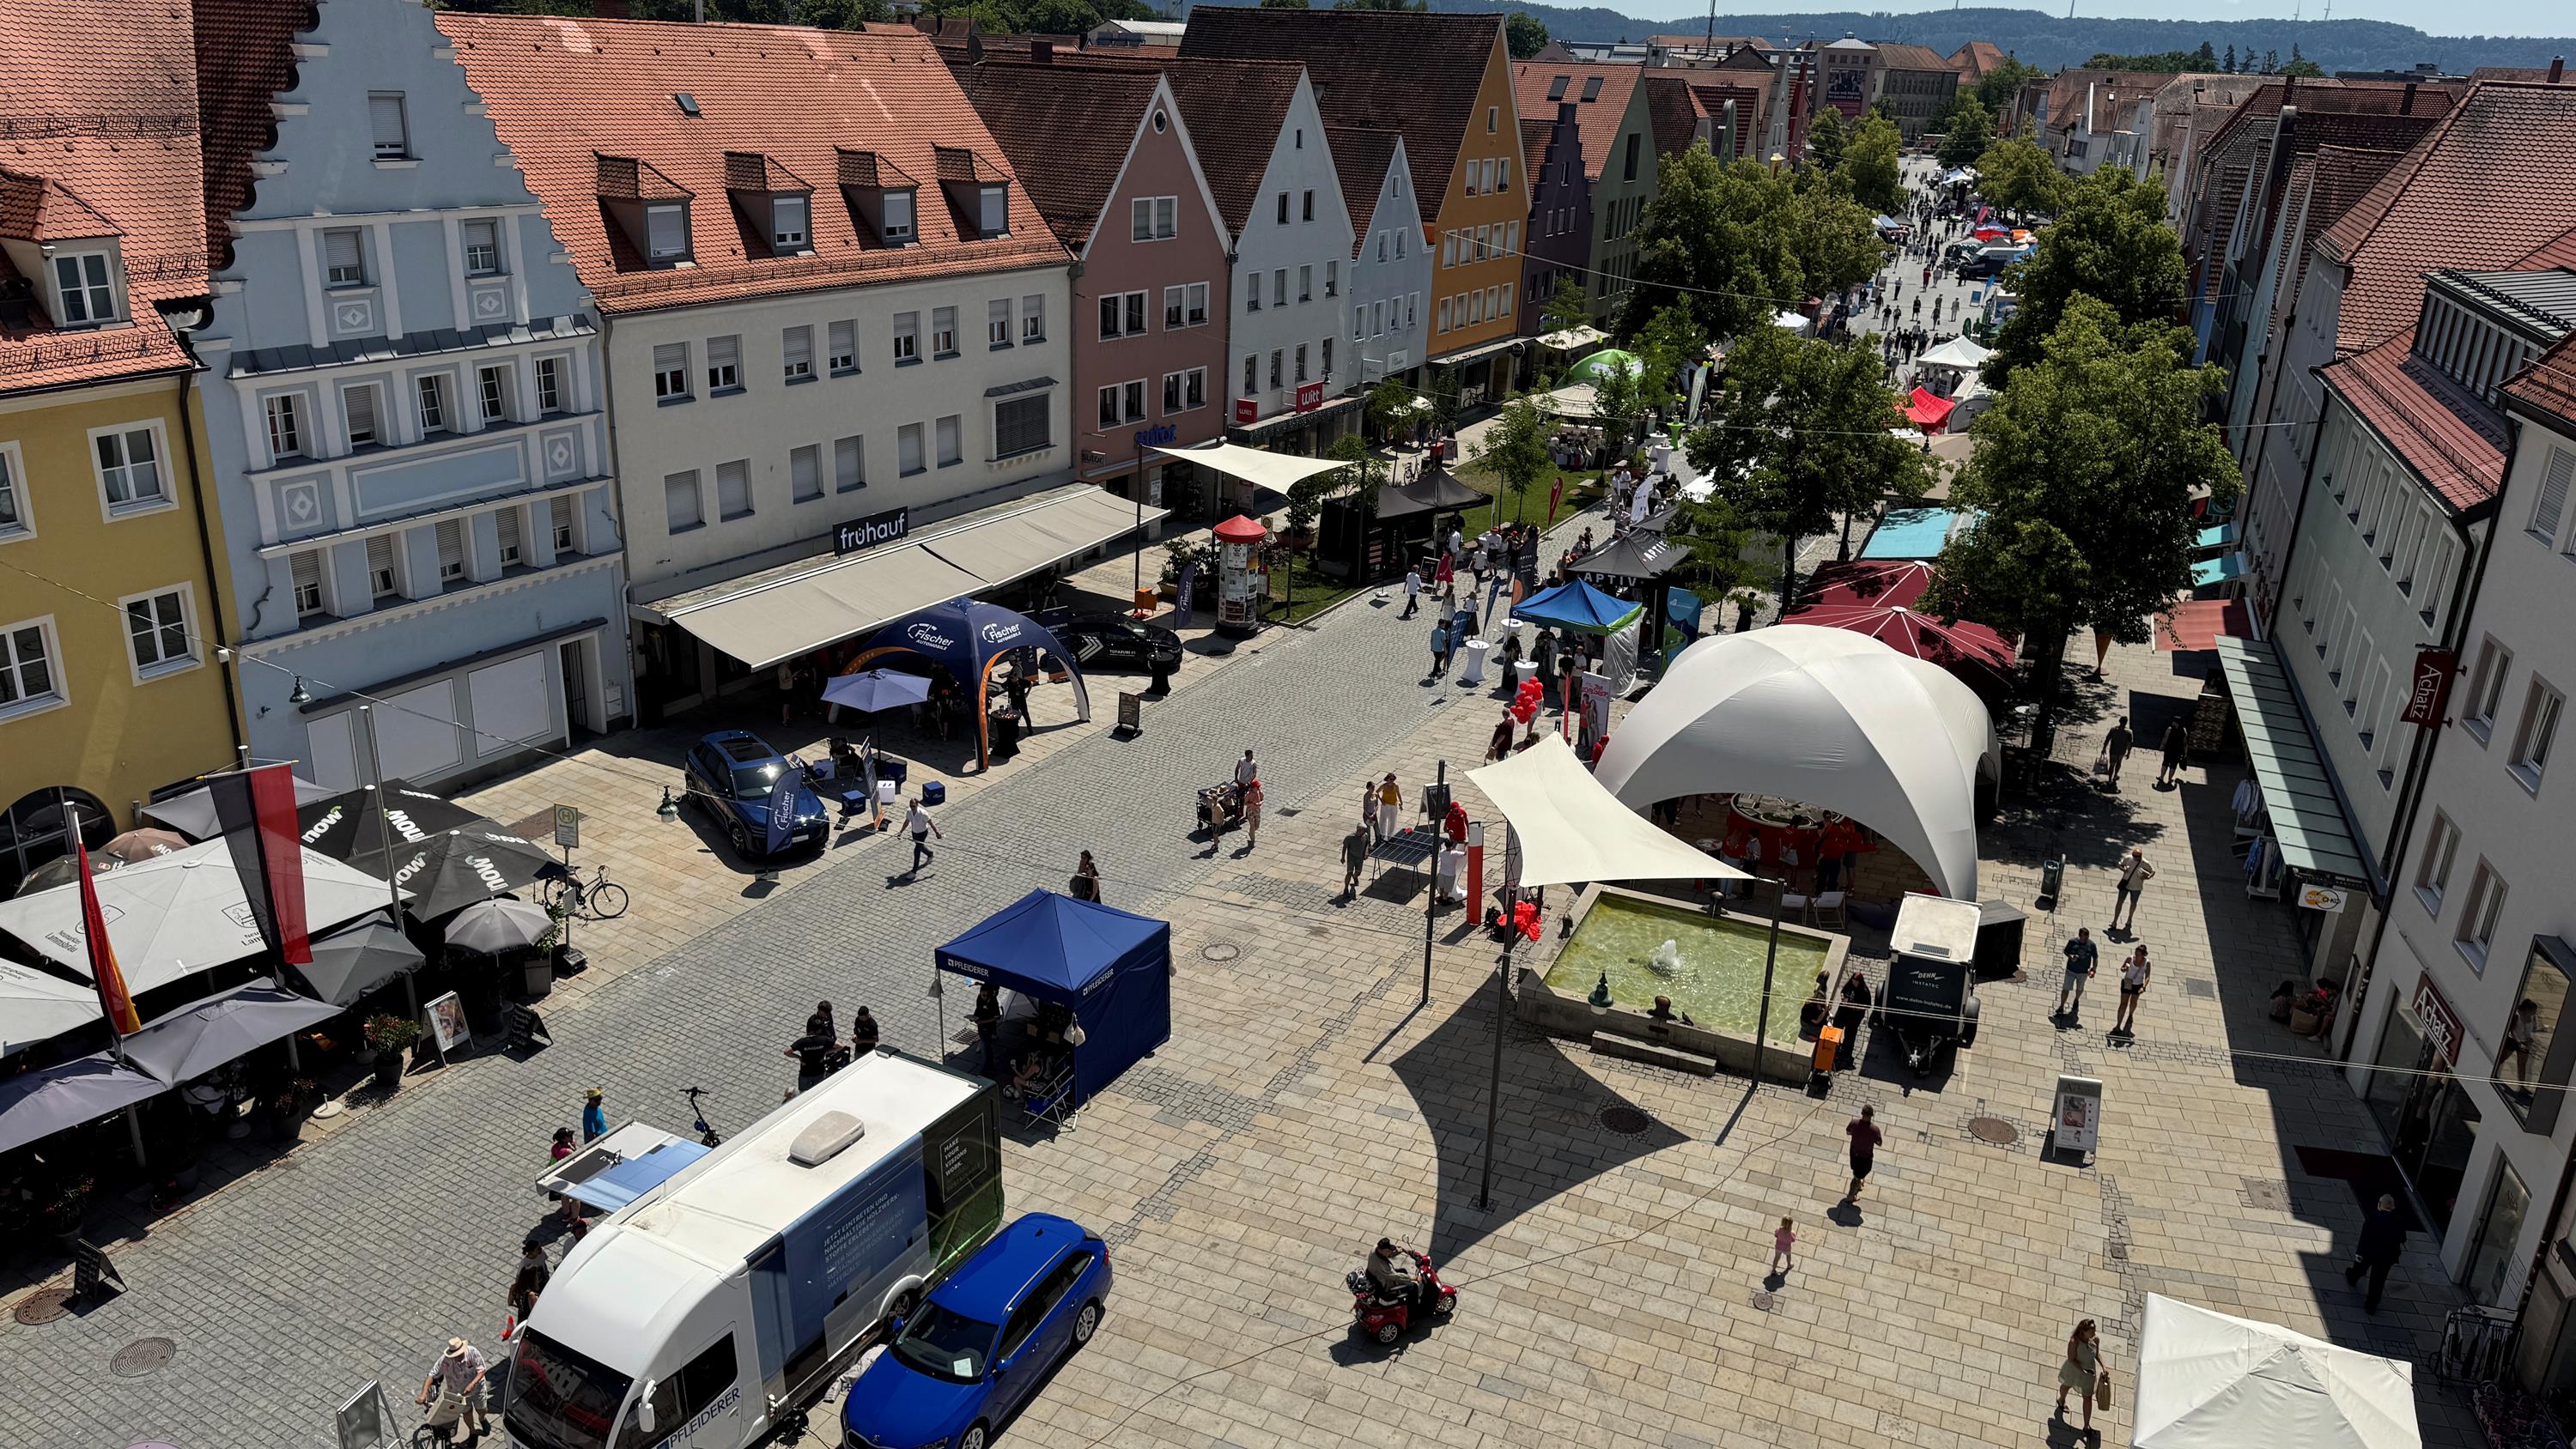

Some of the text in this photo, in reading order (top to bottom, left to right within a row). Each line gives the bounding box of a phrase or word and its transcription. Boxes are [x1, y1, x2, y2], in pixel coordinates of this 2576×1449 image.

[840, 512, 906, 549] frühauf
[1583, 572, 1637, 587] APTIV
[914, 628, 955, 646] Fischer
[989, 624, 1020, 640] Fischer
[997, 631, 1022, 644] AUTOMOBILE
[915, 639, 948, 651] AUTOMOBILE
[2412, 663, 2443, 718] Achatz
[780, 790, 790, 824] Fischer
[301, 806, 343, 844] now
[954, 959, 989, 977] PFLEIDERER
[1087, 967, 1115, 992] PFLEIDERER
[2413, 985, 2453, 1052] Achatz
[945, 1137, 959, 1153] MAKE
[945, 1145, 959, 1161] YOUR
[945, 1147, 968, 1168] VISIONS
[824, 1192, 889, 1247] JETZT EINTRETEN UND
[670, 1387, 741, 1448] PFLEIDERER
